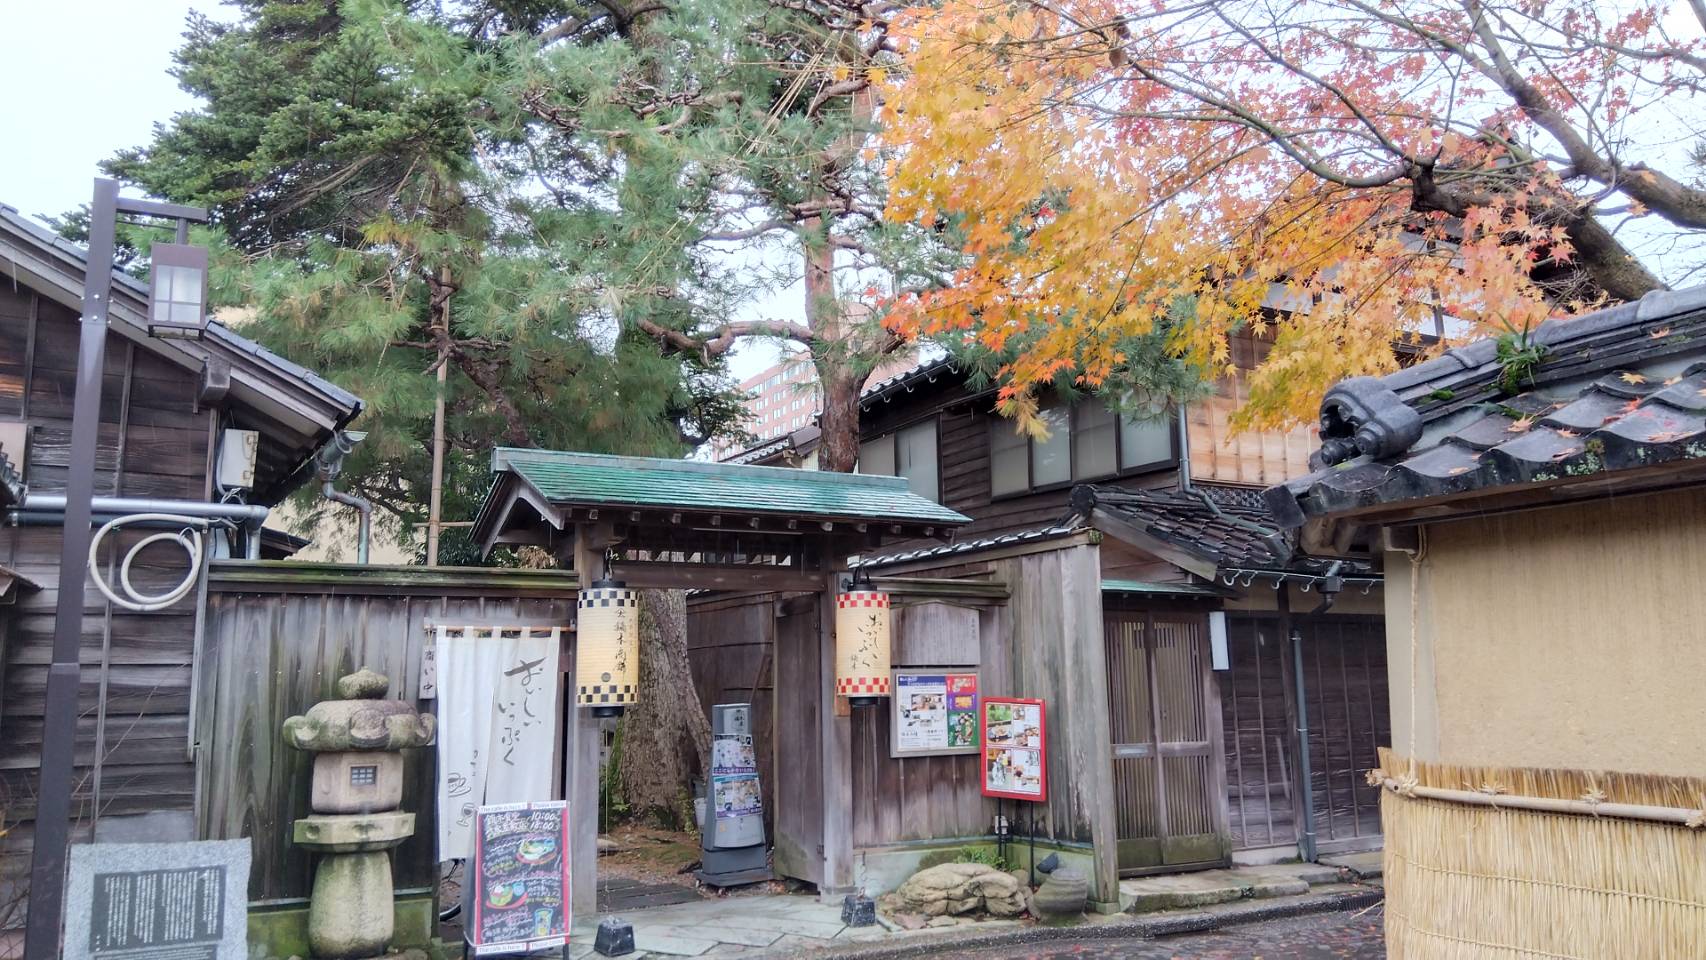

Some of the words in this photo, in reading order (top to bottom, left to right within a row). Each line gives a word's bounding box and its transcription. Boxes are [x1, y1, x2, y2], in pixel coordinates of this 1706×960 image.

[868, 611, 883, 660] おいしい
[504, 656, 547, 727] おいしい
[498, 702, 521, 766] いっぷく
